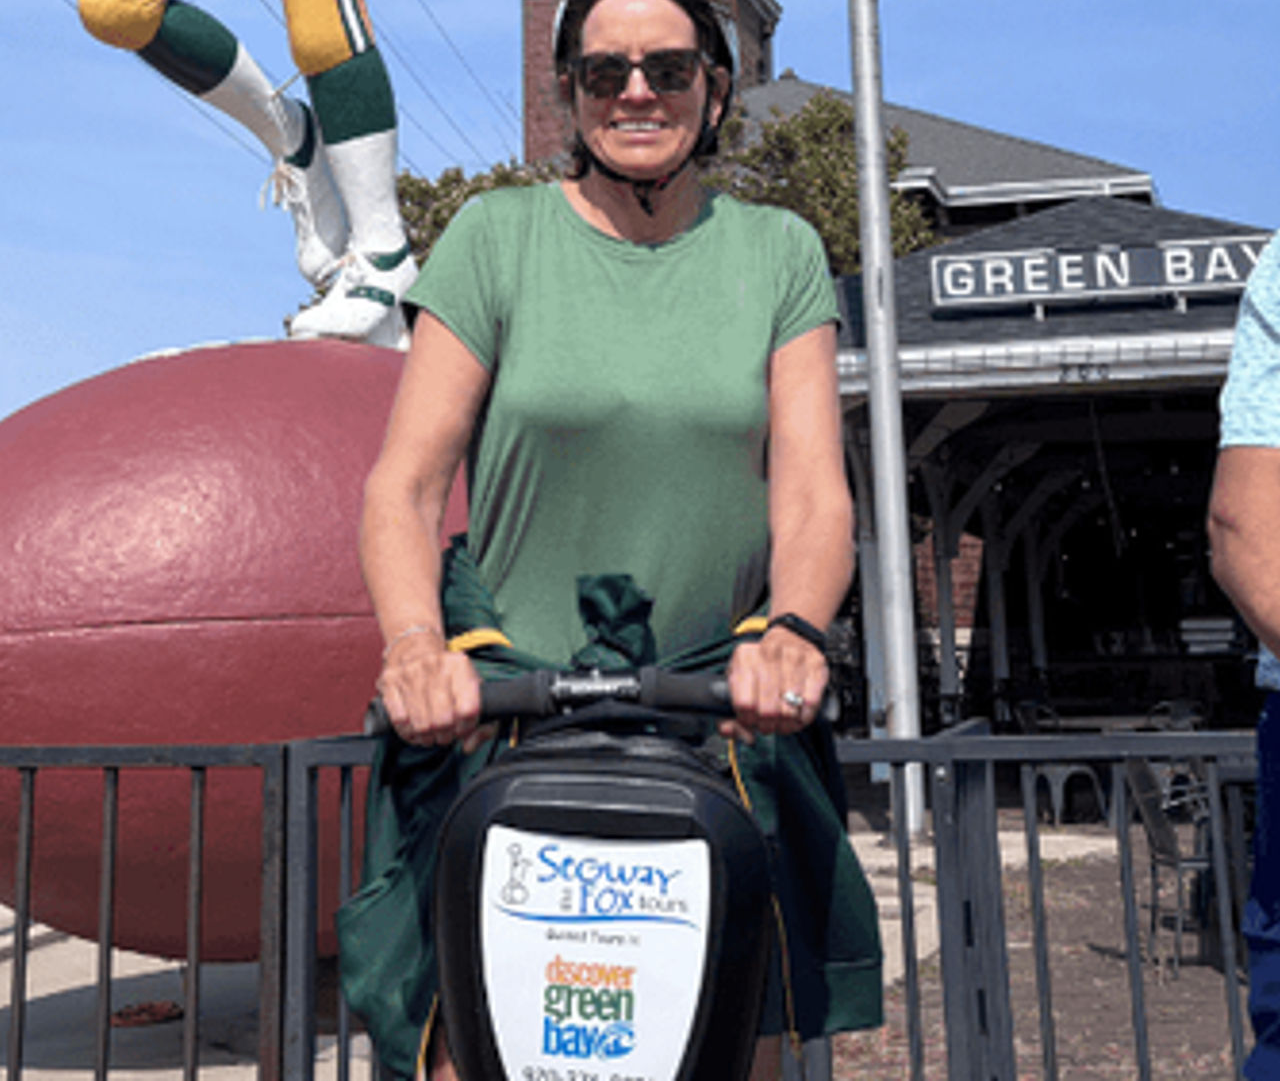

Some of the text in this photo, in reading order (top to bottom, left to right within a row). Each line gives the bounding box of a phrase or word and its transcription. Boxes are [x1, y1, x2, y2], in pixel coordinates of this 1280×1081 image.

[943, 251, 1130, 296] GREEN
[545, 954, 637, 987] discover
[544, 984, 634, 1023] green
